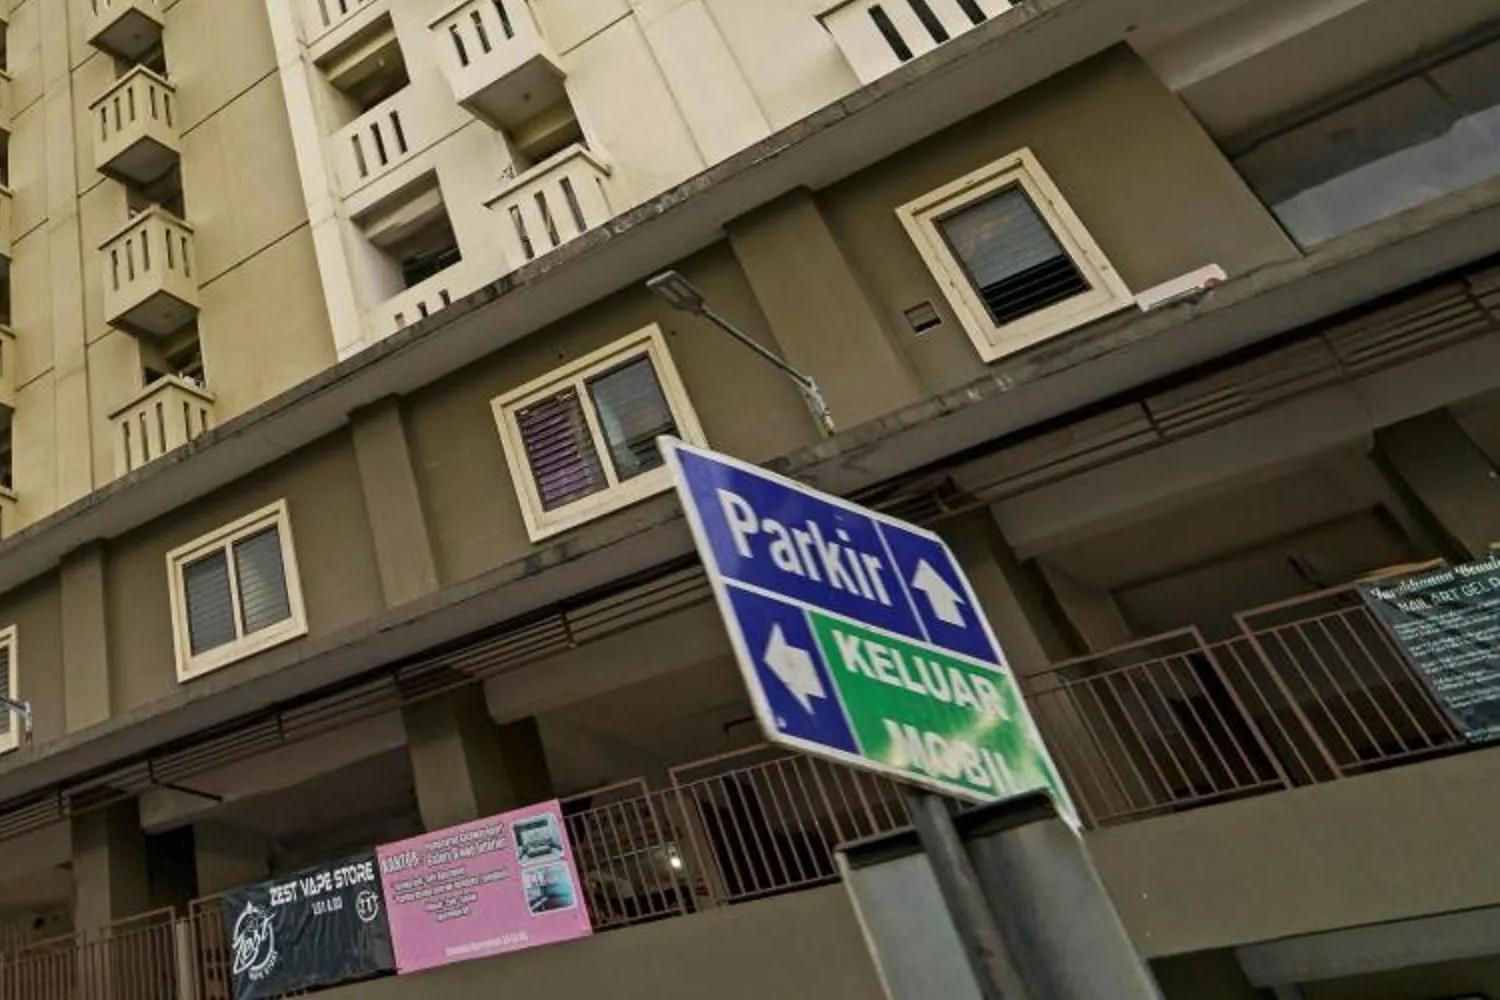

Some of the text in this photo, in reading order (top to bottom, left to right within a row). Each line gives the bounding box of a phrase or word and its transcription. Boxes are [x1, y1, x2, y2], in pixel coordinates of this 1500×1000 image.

[716, 489, 893, 605] Parkir
[1431, 587, 1460, 605] ART
[832, 629, 1011, 721] KELUAR
[269, 881, 297, 906] ZEST
[300, 872, 332, 896] VAPE
[333, 862, 375, 889] STORE
